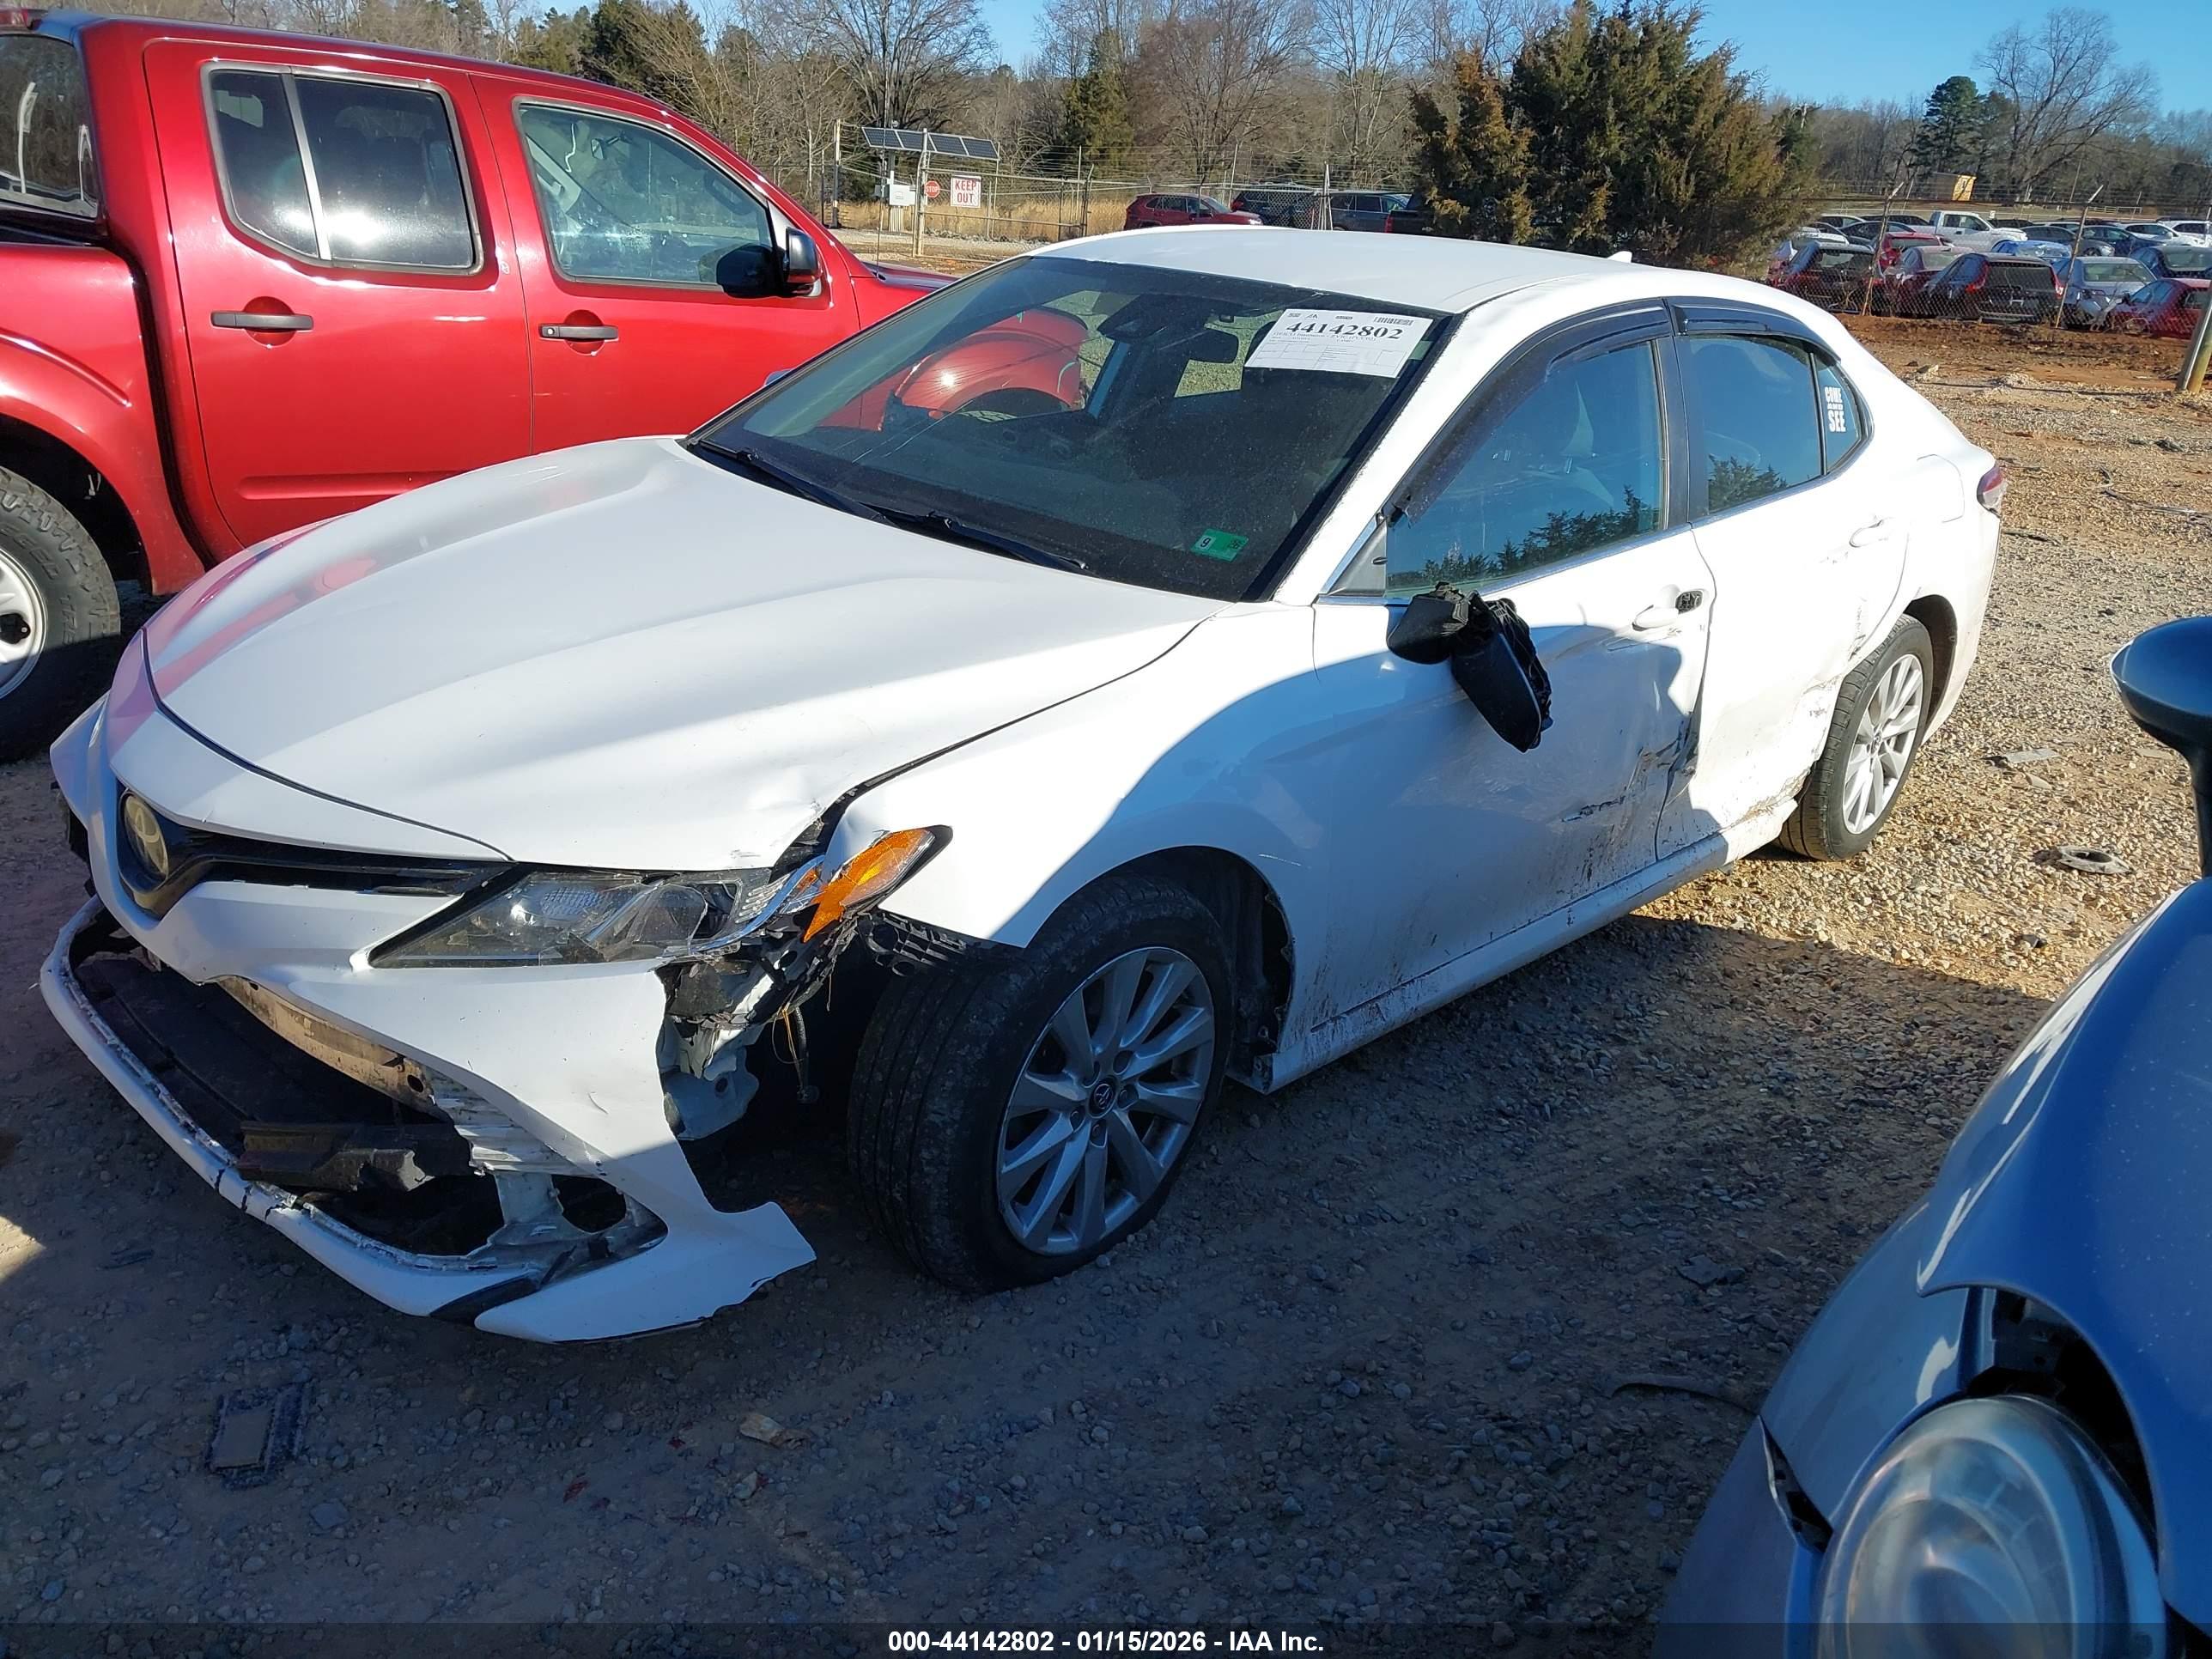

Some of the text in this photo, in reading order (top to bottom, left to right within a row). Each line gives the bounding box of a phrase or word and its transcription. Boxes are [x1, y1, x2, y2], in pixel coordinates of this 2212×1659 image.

[955, 179, 976, 191] KEEP
[957, 192, 974, 204] OUT
[1287, 321, 1403, 340] 44142802
[1825, 386, 1842, 403] COME
[1828, 410, 1846, 432] SEE
[1200, 538, 1211, 547] 9
